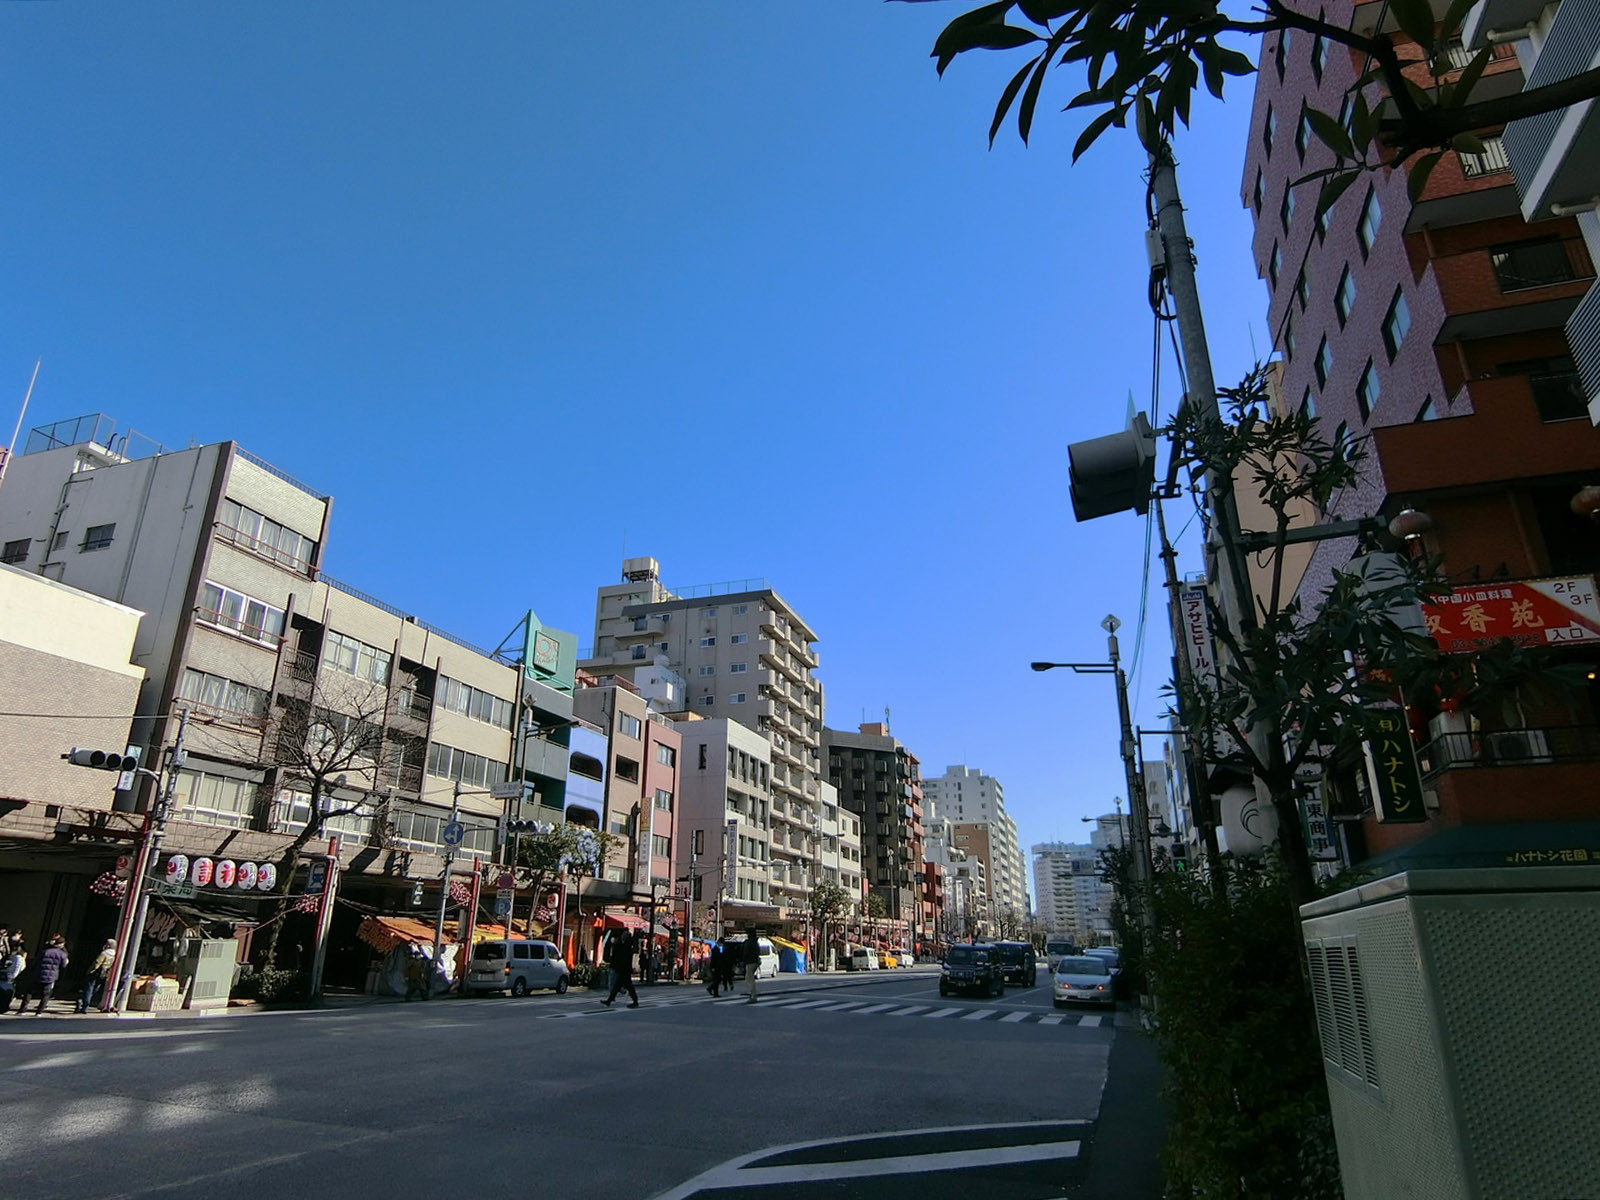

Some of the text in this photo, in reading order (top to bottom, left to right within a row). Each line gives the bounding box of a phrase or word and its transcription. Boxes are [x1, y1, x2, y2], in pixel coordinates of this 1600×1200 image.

[1553, 581, 1576, 594] 2F
[1569, 593, 1593, 606] 3F
[1186, 600, 1209, 669] アサヒビール
[1552, 627, 1584, 641] 入口
